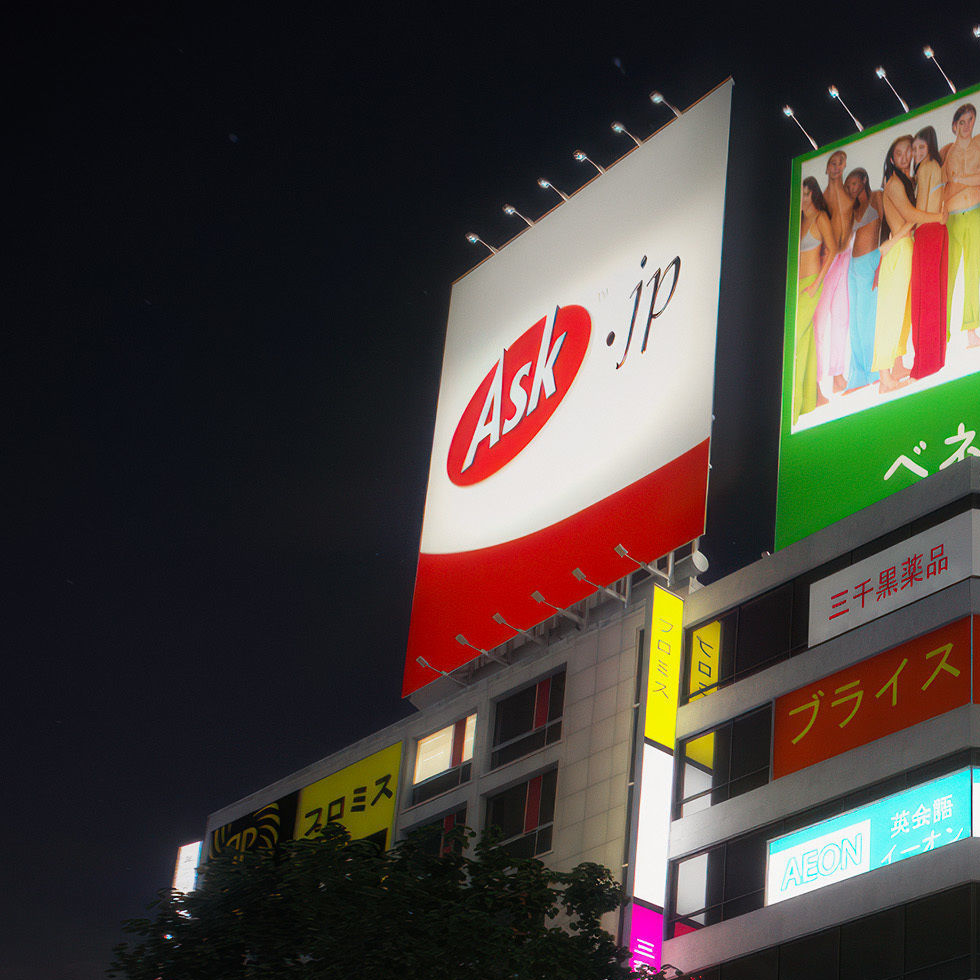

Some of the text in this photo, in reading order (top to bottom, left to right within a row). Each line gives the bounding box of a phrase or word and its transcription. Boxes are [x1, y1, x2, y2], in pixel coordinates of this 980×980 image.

[461, 305, 568, 473] Ask
[829, 543, 949, 621] 三千黒薬品
[781, 833, 863, 892] AEON
